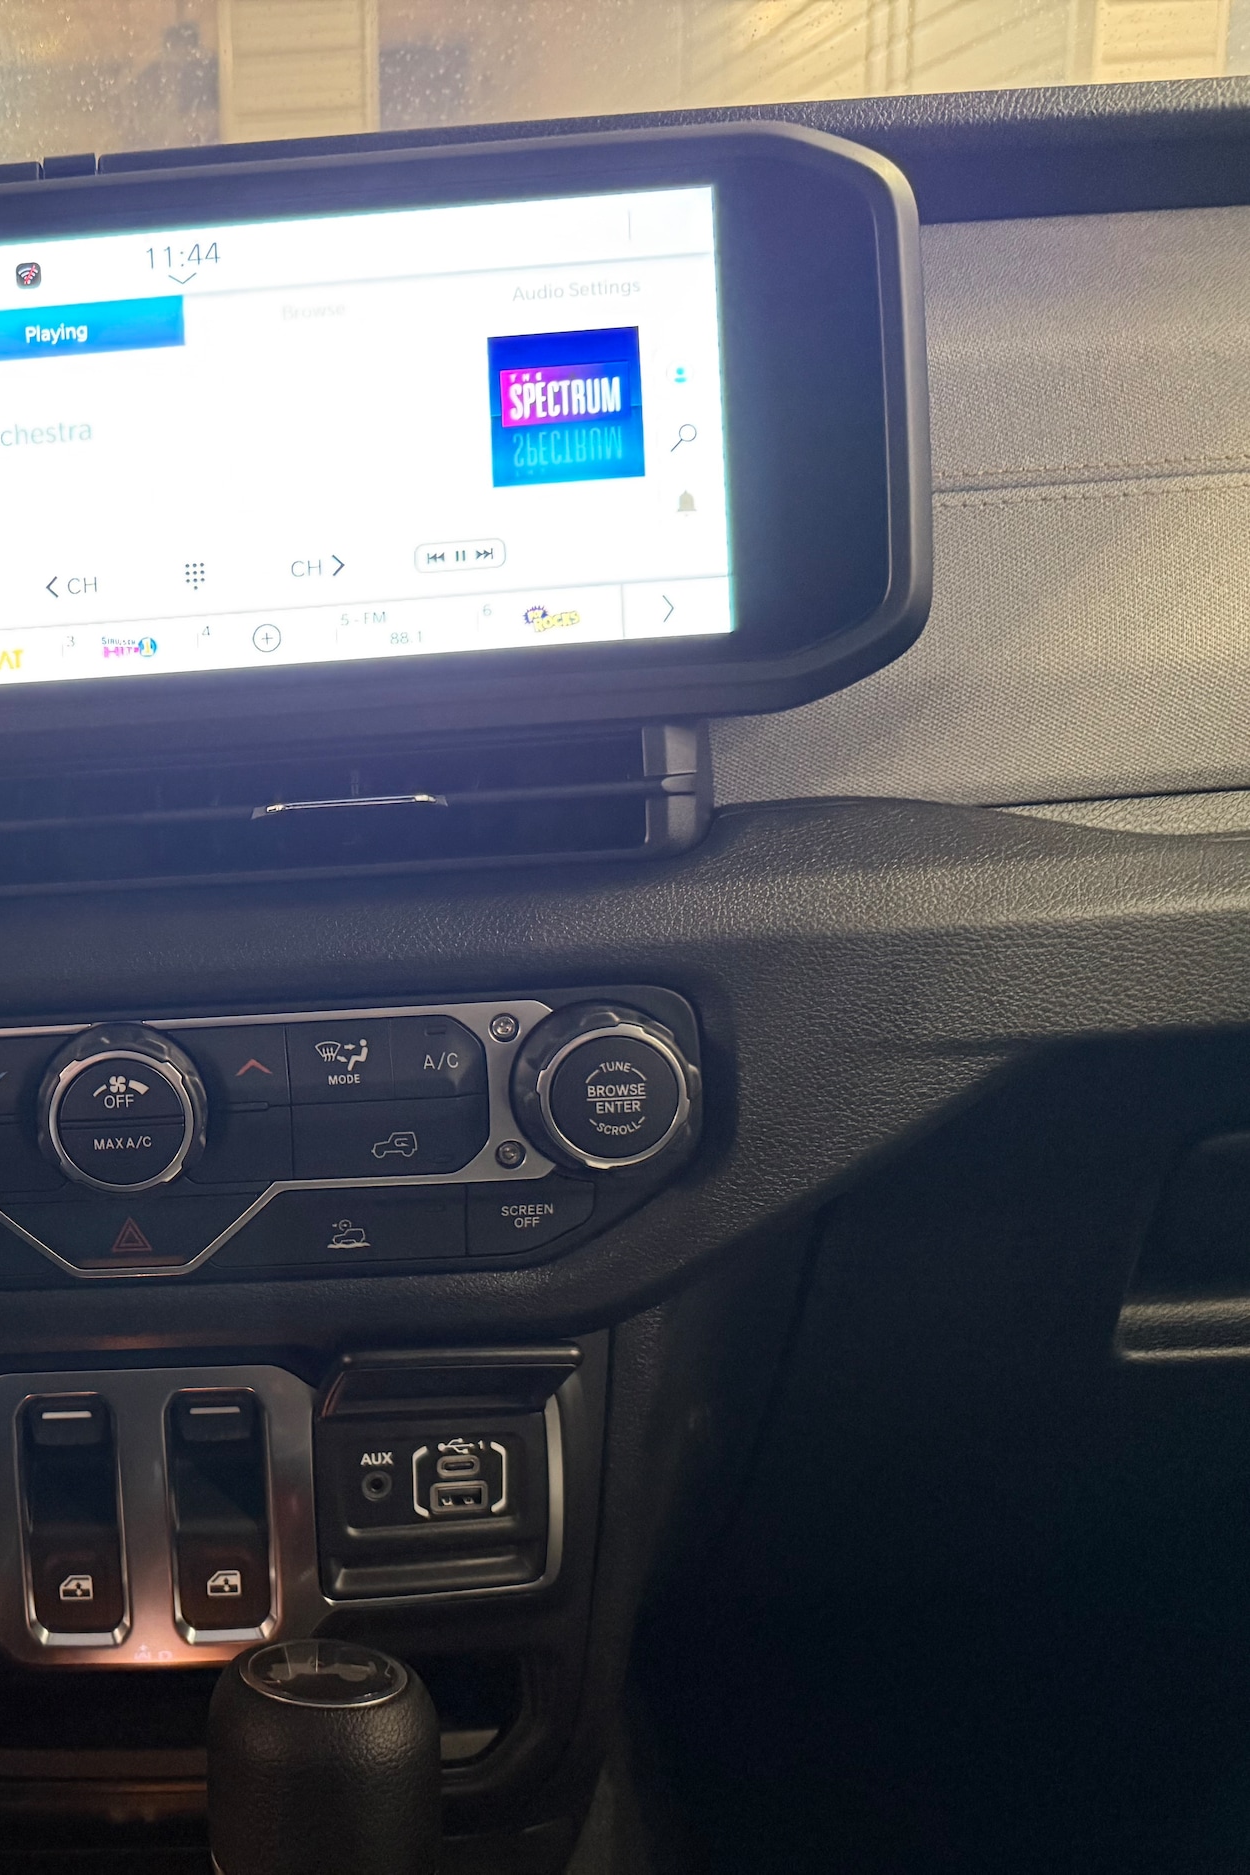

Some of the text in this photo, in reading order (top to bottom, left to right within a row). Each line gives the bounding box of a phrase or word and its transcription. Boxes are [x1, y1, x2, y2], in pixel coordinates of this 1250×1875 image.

[146, 242, 222, 270] 11:44
[512, 277, 641, 302] Audio Settings
[281, 300, 346, 321] Browse
[25, 323, 88, 345] Playing
[508, 376, 622, 421] SPECTRUM
[291, 559, 322, 577] CH
[67, 576, 98, 596] CH
[363, 611, 386, 624] FM
[482, 604, 492, 617] 6
[533, 611, 580, 633] ROCKS
[201, 625, 211, 637] 4
[390, 630, 423, 645] 88.1
[66, 636, 75, 648] 3
[423, 1051, 459, 1071] A/C
[600, 1061, 632, 1075] TUNE
[327, 1072, 361, 1086] MODE
[587, 1082, 646, 1098] BROWSE
[103, 1093, 135, 1110] OFF
[595, 1099, 642, 1114] ENTER
[597, 1118, 642, 1136] SCROLL
[93, 1135, 152, 1151] MAX A/C
[501, 1203, 555, 1217] SCREEN
[513, 1215, 541, 1229] OFF
[360, 1451, 394, 1466] AUX
